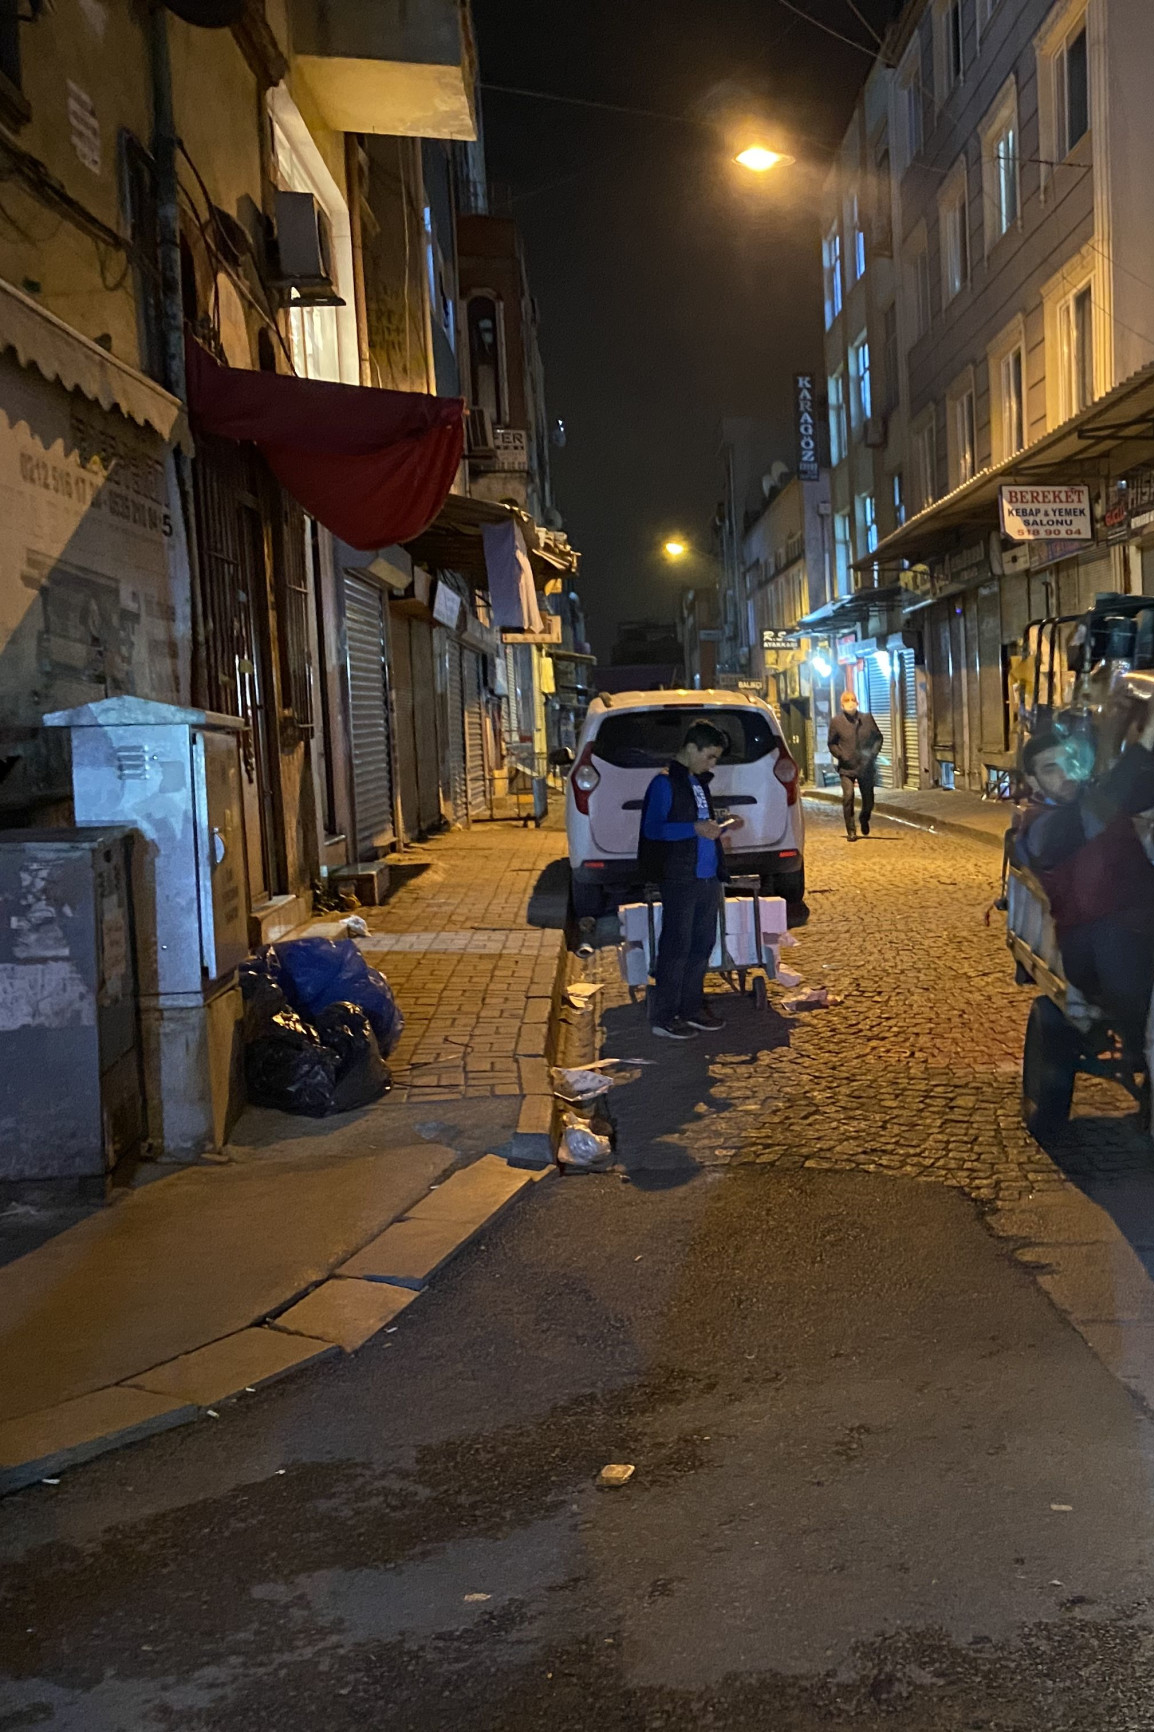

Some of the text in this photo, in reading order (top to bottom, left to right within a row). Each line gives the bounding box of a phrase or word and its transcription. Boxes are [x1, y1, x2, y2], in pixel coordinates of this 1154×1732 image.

[797, 376, 815, 462] KARAGÖZ
[1008, 490, 1084, 504] BEREKET
[1008, 508, 1086, 517] KEBAP & YEMEK
[1024, 519, 1073, 527] SALONU
